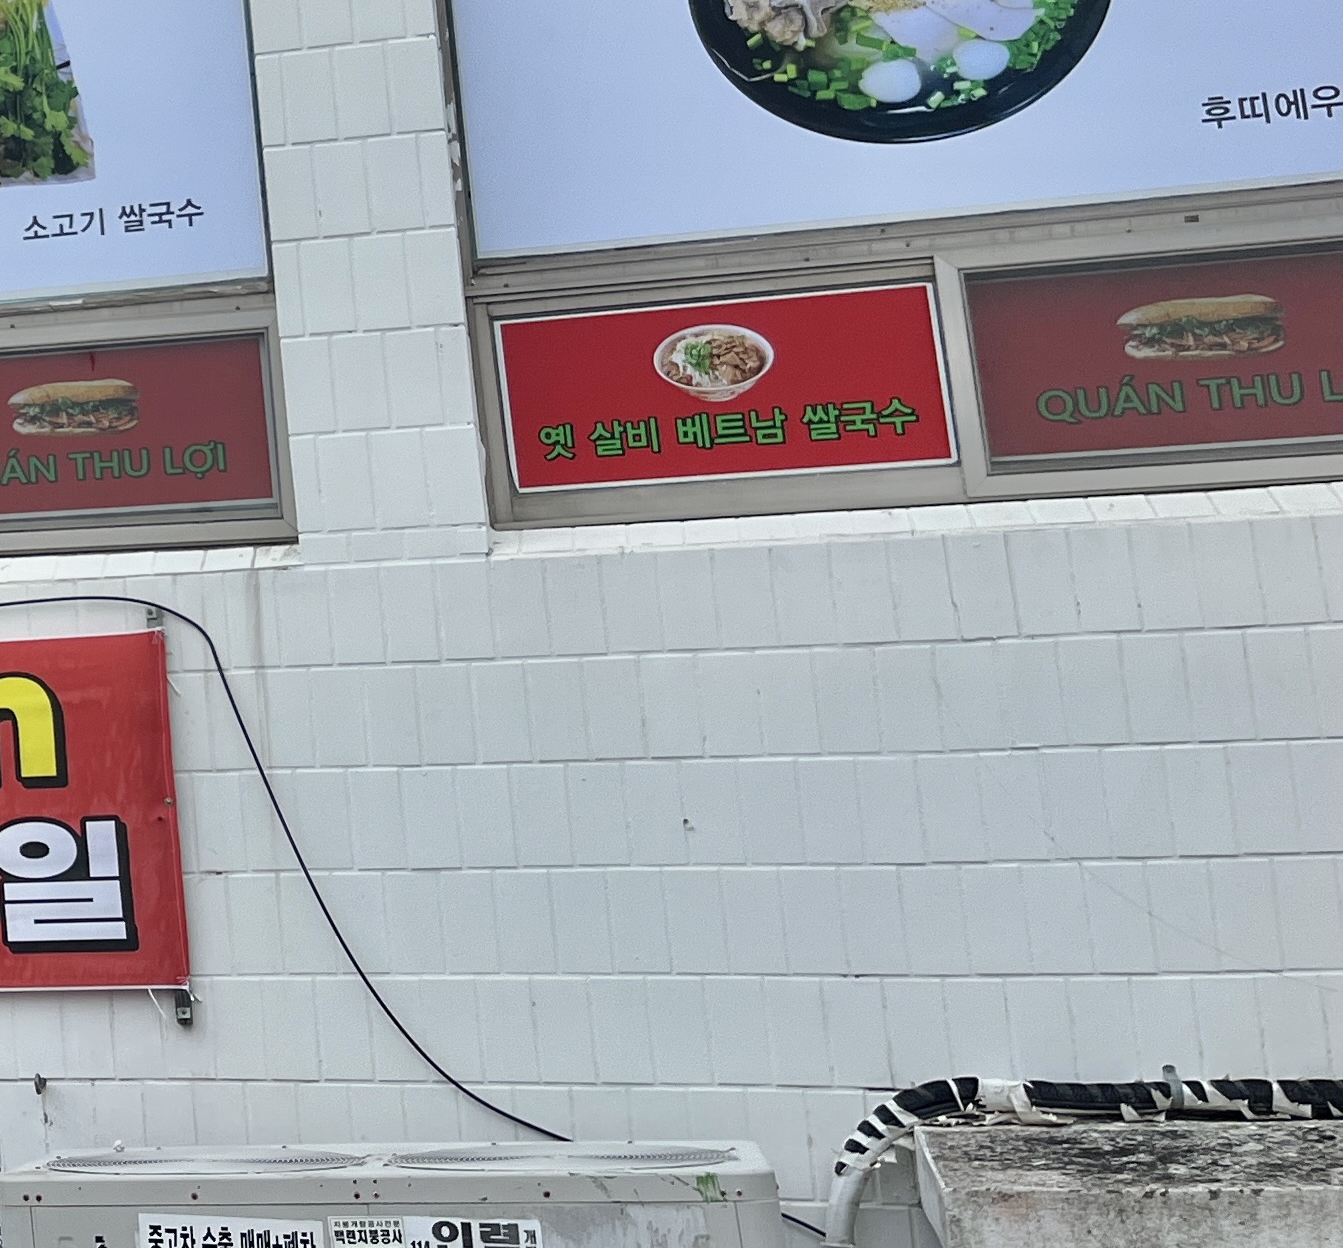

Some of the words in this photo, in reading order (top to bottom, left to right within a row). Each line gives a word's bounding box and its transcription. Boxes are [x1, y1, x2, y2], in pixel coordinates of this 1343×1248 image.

[1201, 85, 1343, 129] 후띠에우
[22, 207, 105, 240] 소고기
[117, 198, 205, 233] 쌀국수
[1036, 375, 1185, 424] QUÁN
[1197, 371, 1304, 410] THU
[537, 422, 575, 462] 옛
[588, 414, 661, 456] 살비
[676, 404, 786, 452] 베트남
[800, 396, 918, 443] 쌀국수
[67, 447, 150, 483] THU
[163, 441, 227, 481] LỢI
